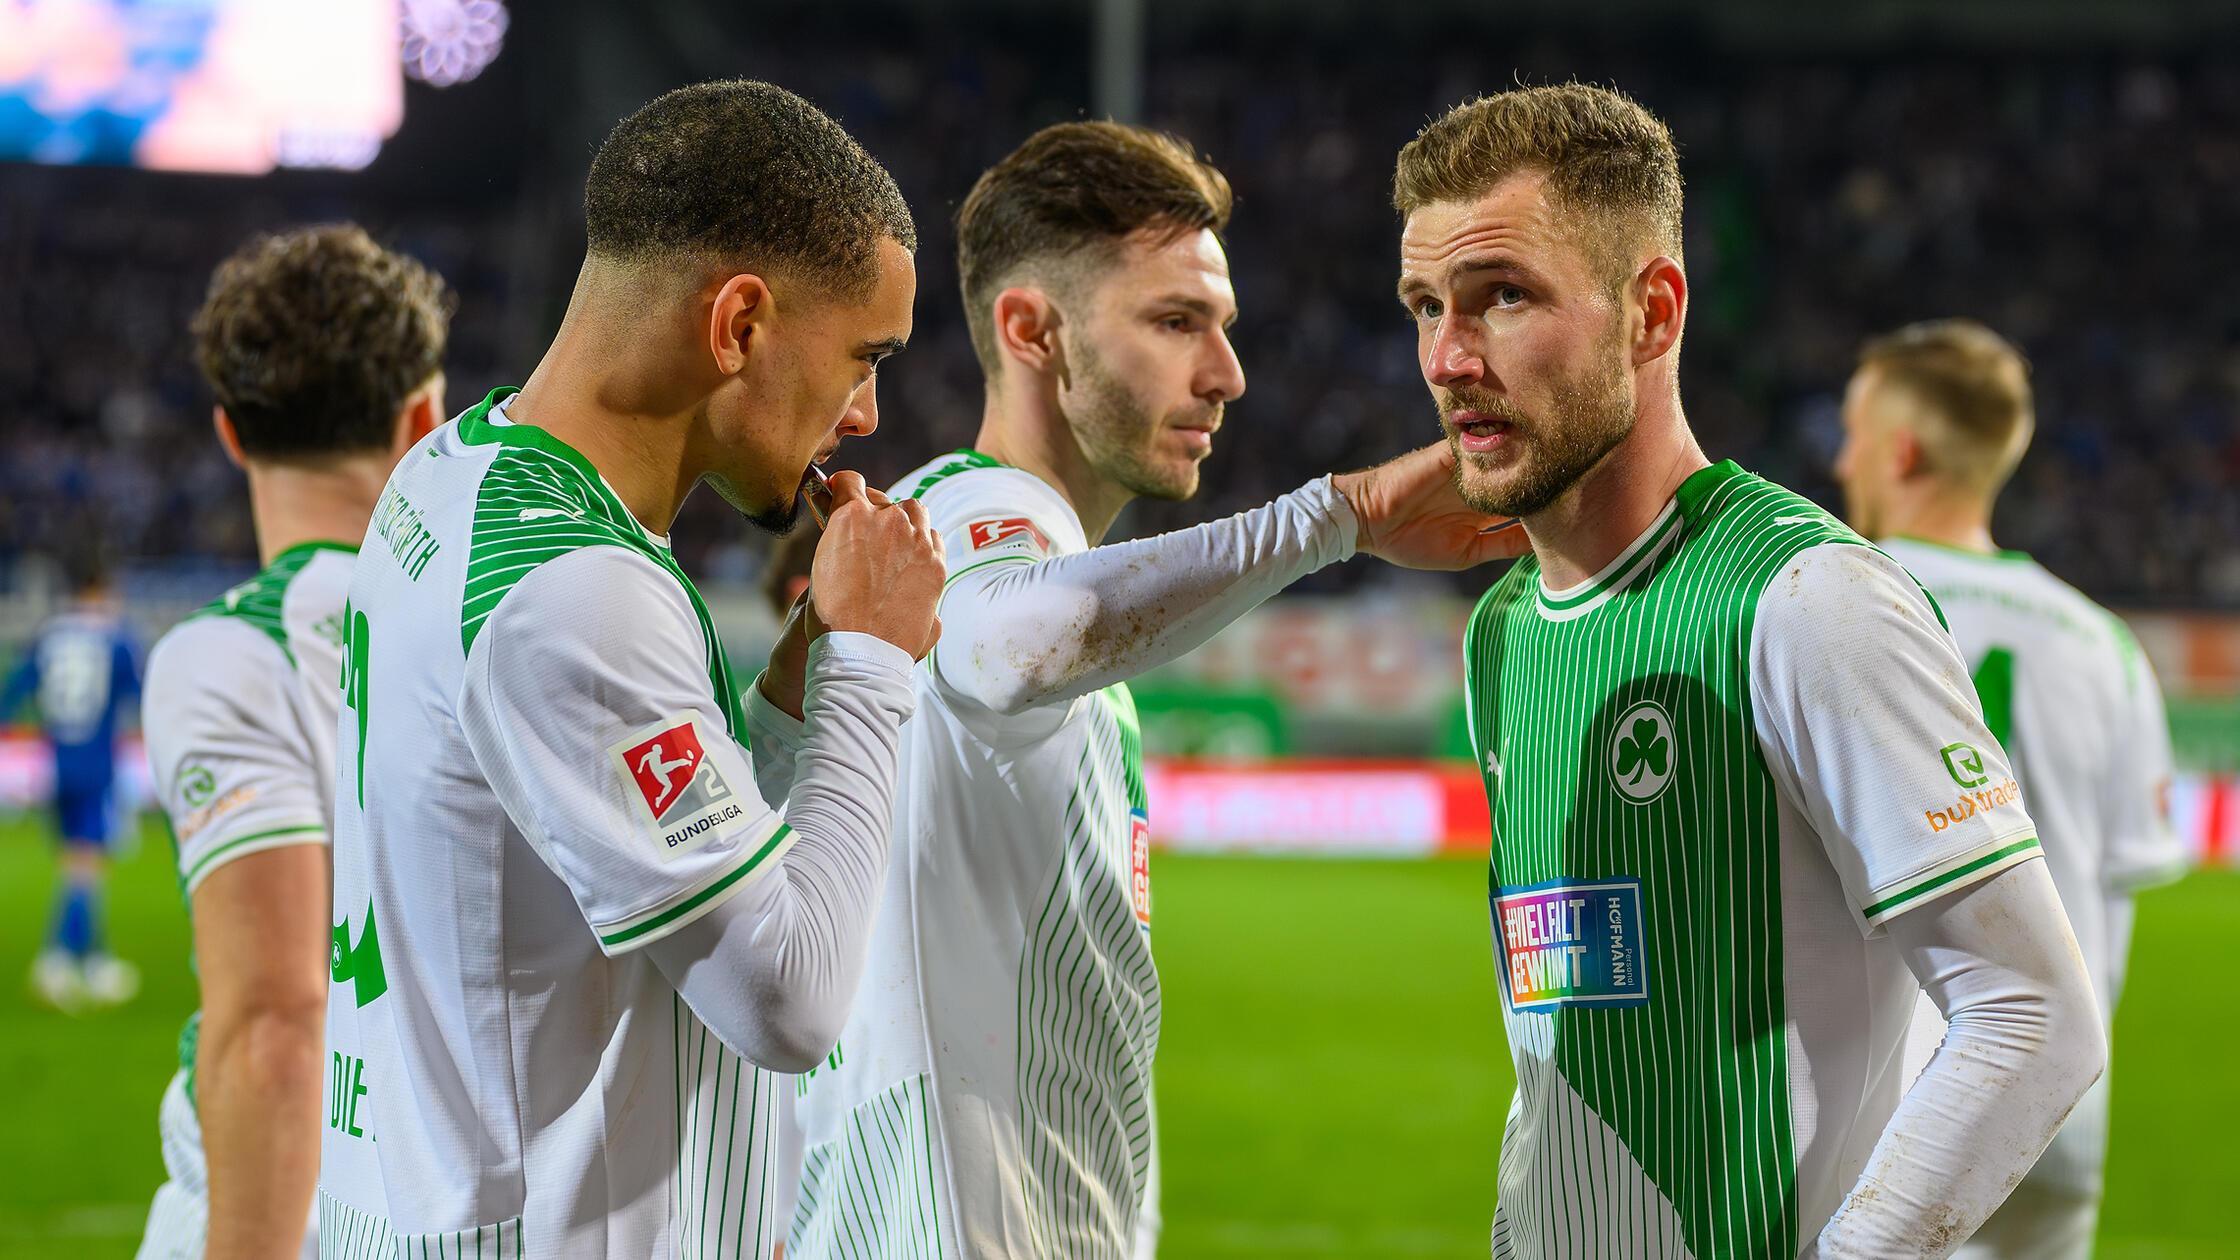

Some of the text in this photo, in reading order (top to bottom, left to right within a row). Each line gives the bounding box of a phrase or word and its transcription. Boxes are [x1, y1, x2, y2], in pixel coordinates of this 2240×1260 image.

[698, 761, 726, 798] 2
[665, 804, 743, 848] BUNDESLIGA
[1505, 898, 1585, 949] #VIELFALT
[1511, 945, 1586, 995] GEWINNT
[1625, 948, 1635, 986] Personal
[331, 1050, 367, 1138] DIE
